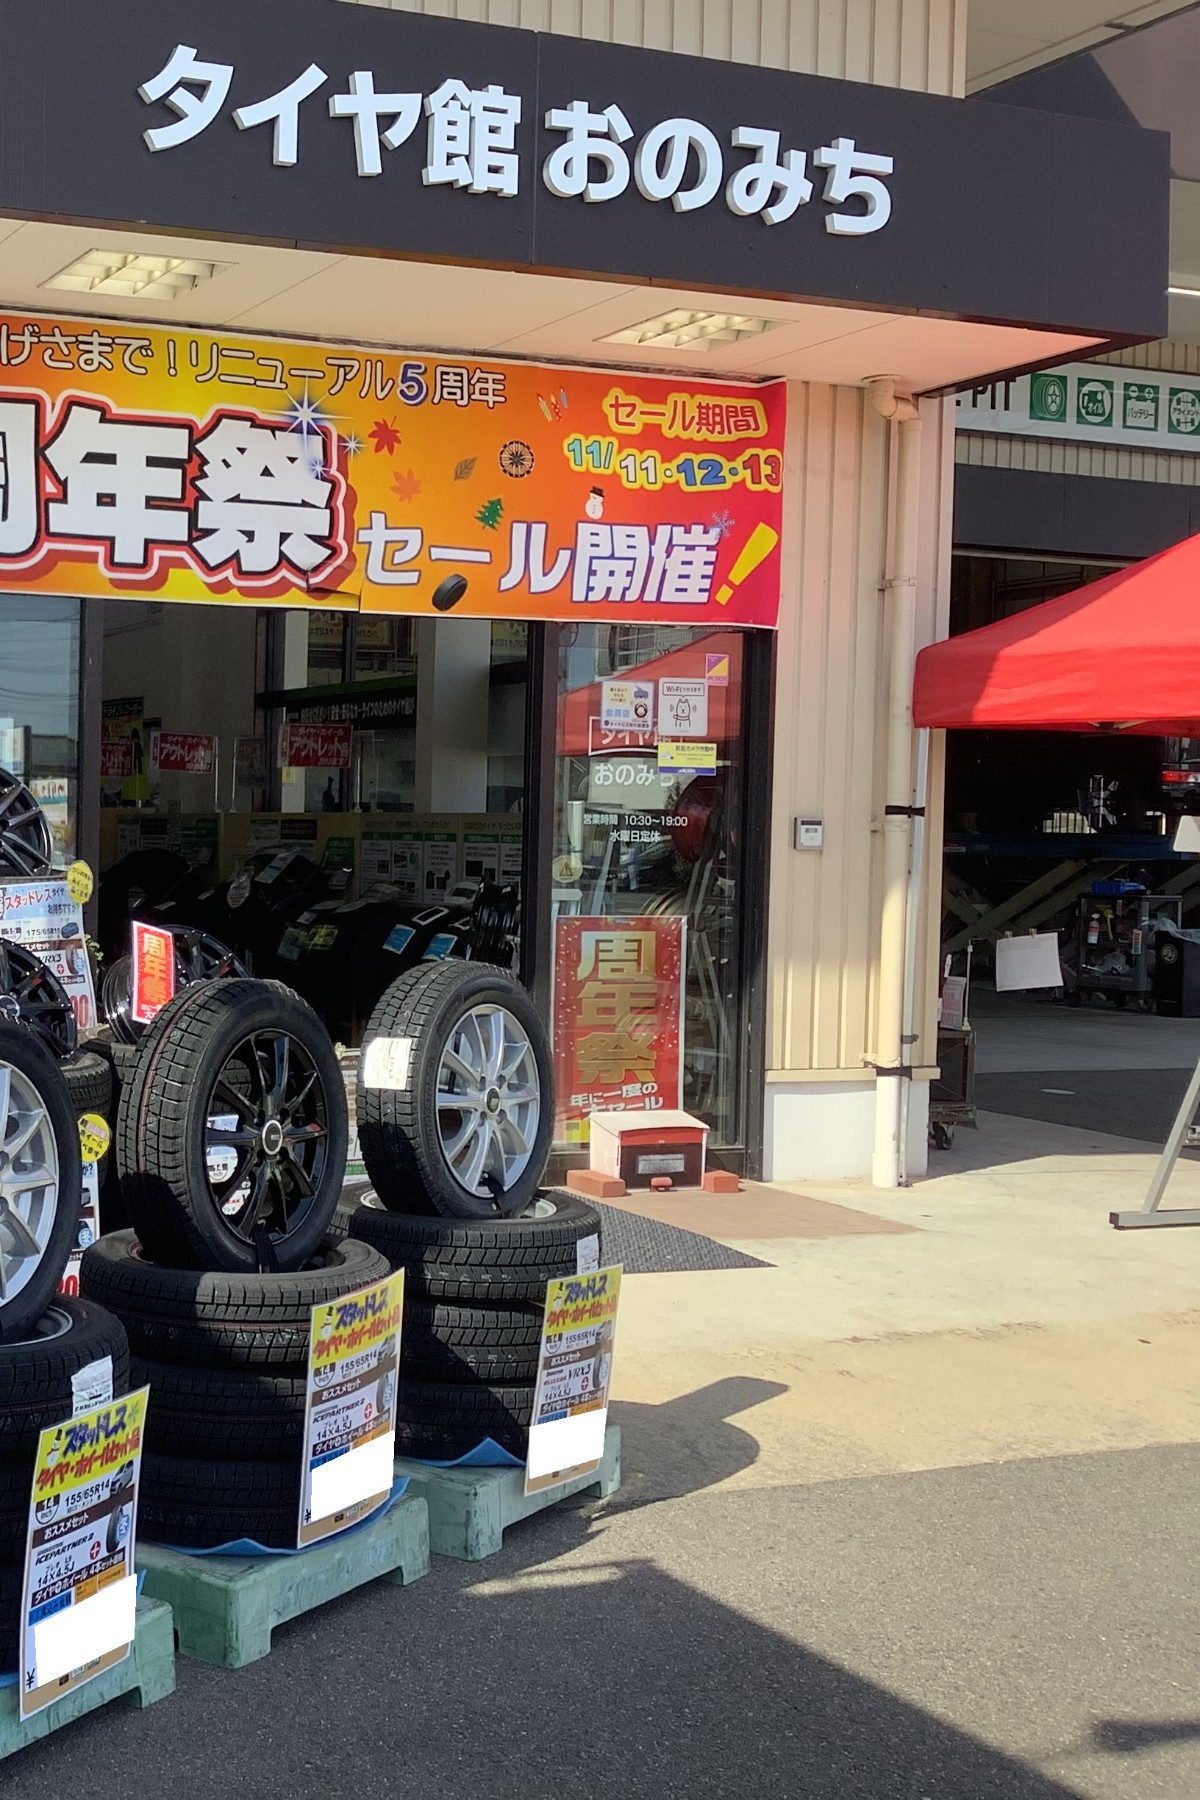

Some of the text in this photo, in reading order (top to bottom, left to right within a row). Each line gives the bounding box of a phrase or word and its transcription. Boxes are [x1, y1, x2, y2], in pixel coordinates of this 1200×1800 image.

[136, 45, 894, 236] タイヤ館 おのみち
[608, 394, 761, 438] セール期間
[1087, 400, 1105, 414] オイル
[1127, 407, 1154, 420] バッテリー
[583, 814, 619, 826] 営業時間
[610, 831, 661, 843] 水曜日定休
[577, 931, 659, 1084] 周年祭
[570, 1082, 658, 1107] 年に一度の
[340, 1350, 378, 1374] 155/65R14
[568, 1363, 592, 1380] VRX3
[322, 1379, 362, 1401] おススメセット
[64, 1481, 110, 1508] 155/65R14
[44, 1512, 89, 1540] おススメセット
[26, 1668, 35, 1689] ¥
